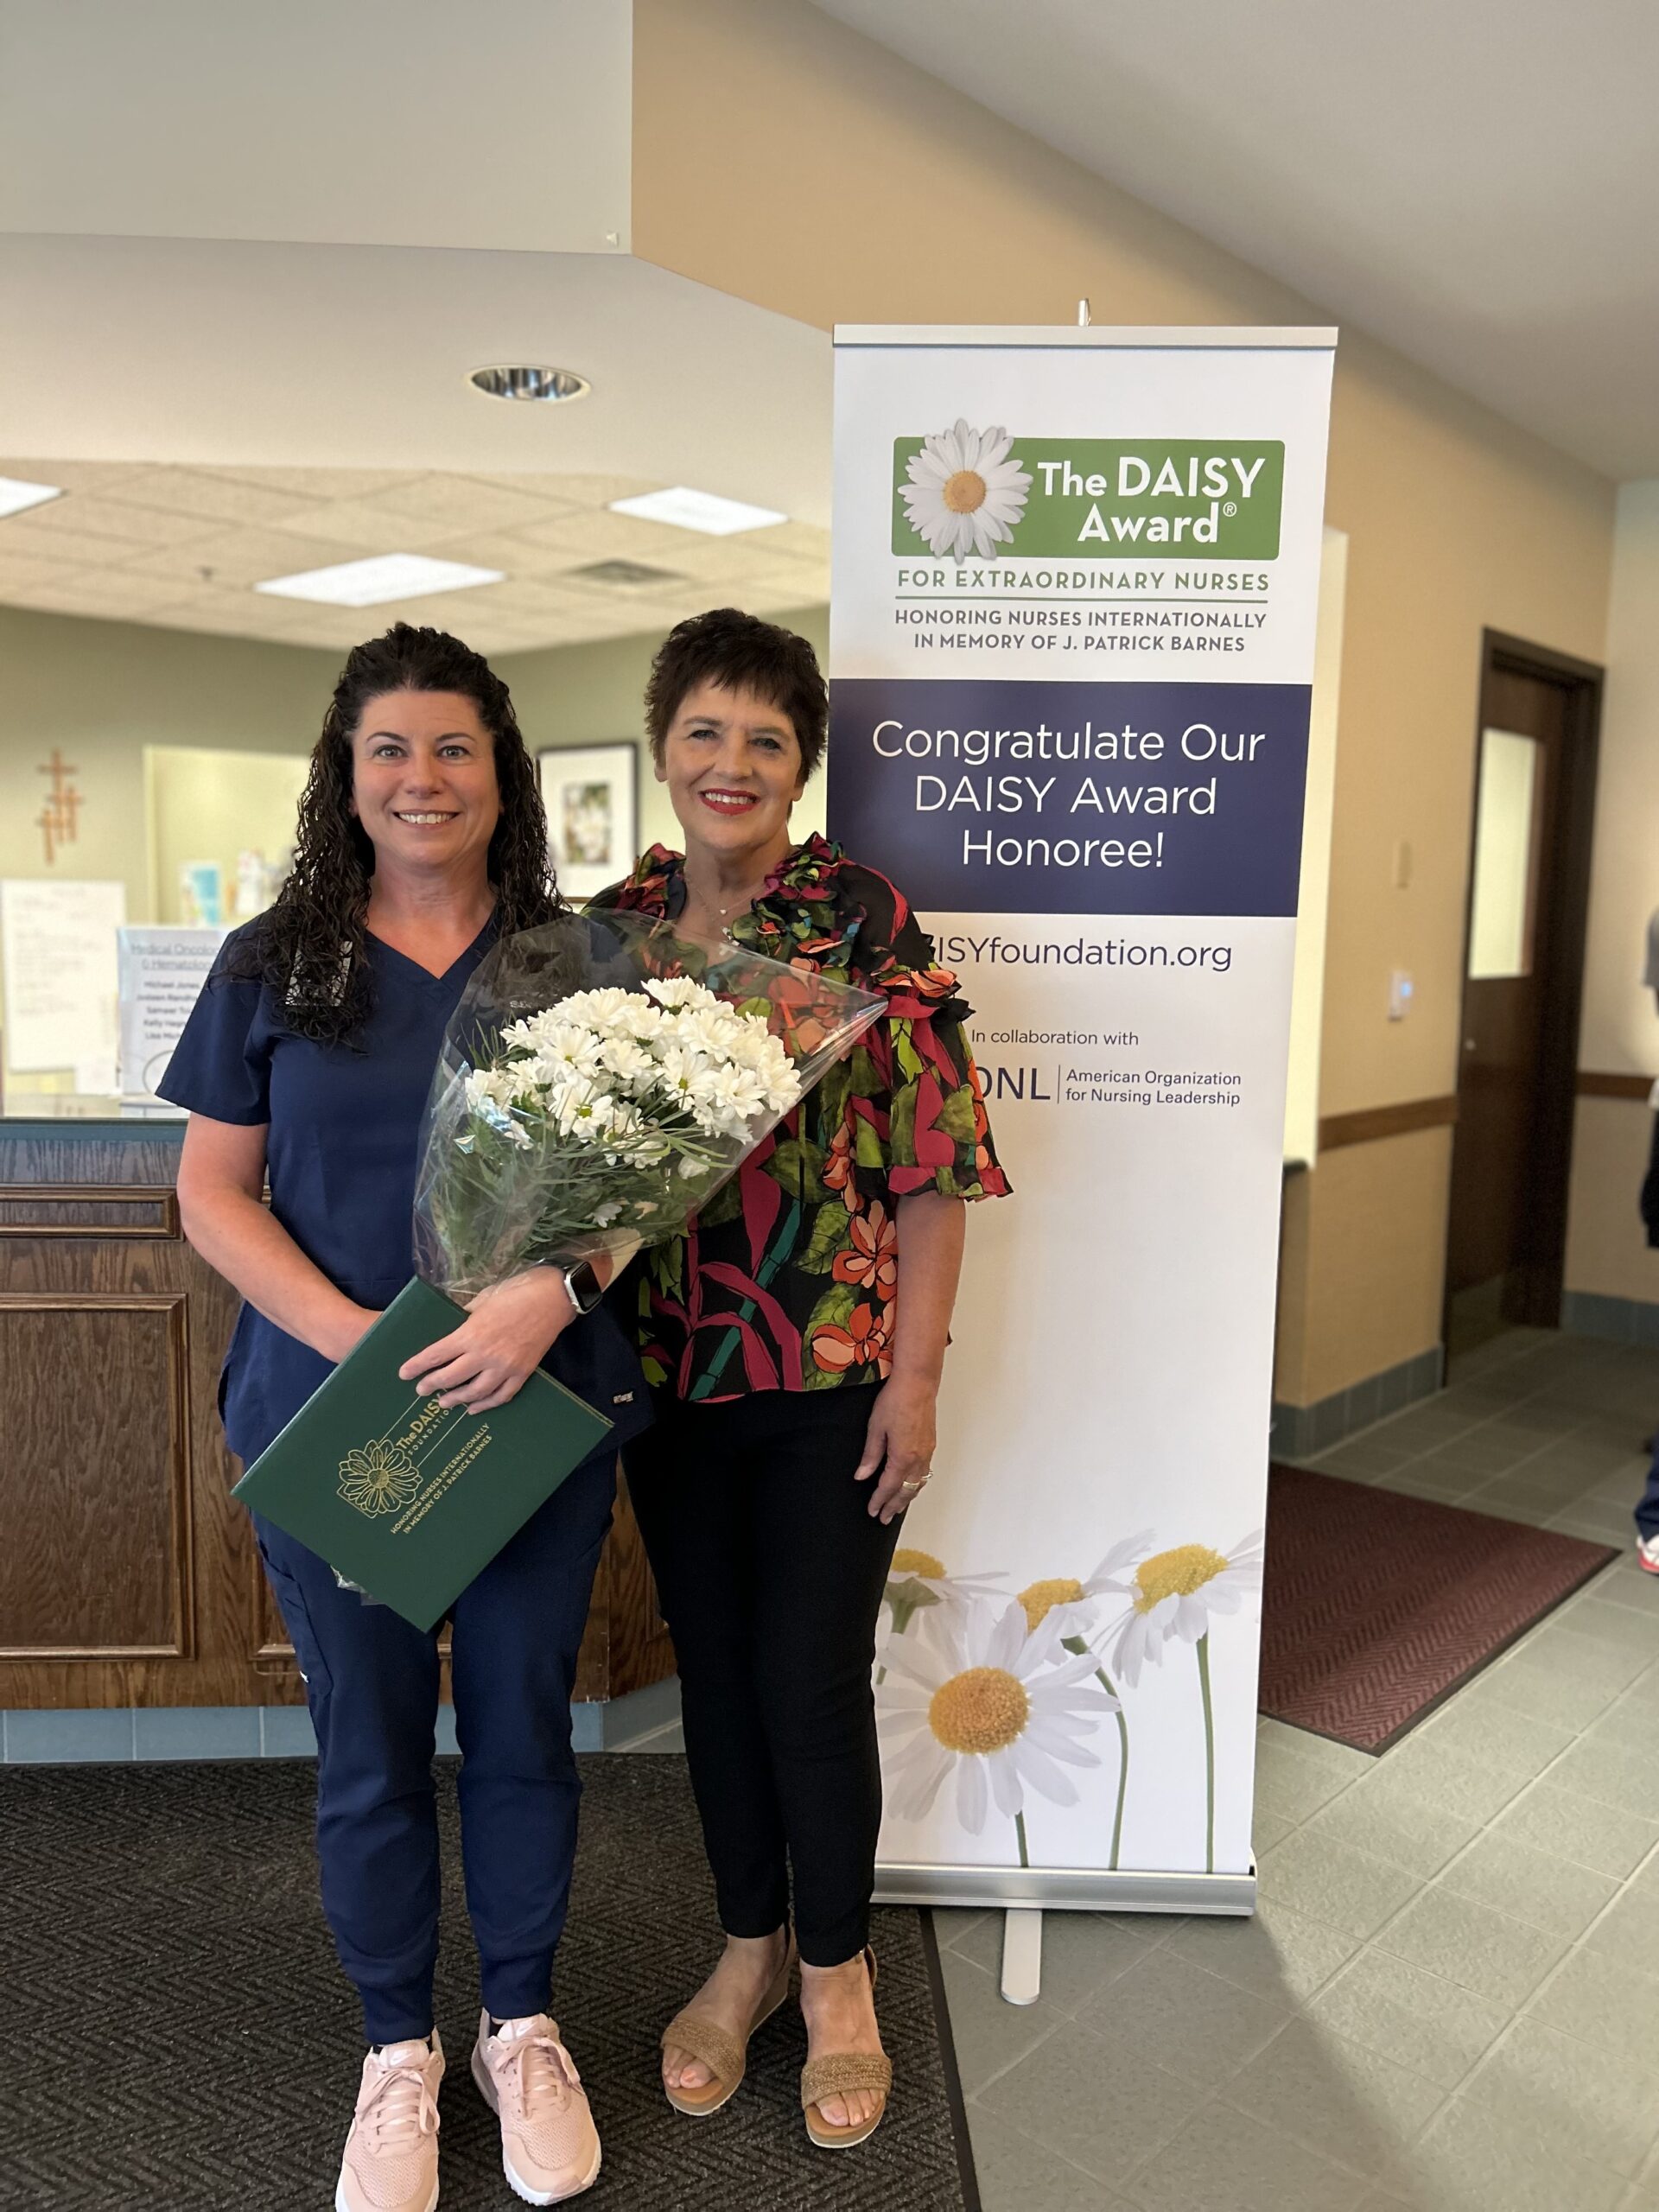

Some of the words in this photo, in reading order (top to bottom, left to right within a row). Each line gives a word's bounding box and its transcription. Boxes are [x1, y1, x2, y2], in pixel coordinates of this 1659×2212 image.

[1038, 461, 1107, 496] The
[1118, 457, 1265, 497] DAISY
[899, 570, 944, 587] FOR
[957, 570, 1164, 588] EXTRAORDINARY
[1175, 573, 1268, 590] NURSES
[896, 610, 1001, 624] HONORING
[1009, 611, 1081, 626] NURSES
[1089, 613, 1266, 627] INTERNATIONALLY
[915, 634, 932, 647] IN
[940, 634, 1025, 648] MEMORY
[1032, 635, 1057, 649] OF
[1063, 636, 1077, 649] J.
[1084, 636, 1164, 650] PATRICK
[1172, 637, 1244, 652] BARNES
[874, 721, 1164, 765] Congratulate
[1182, 724, 1265, 760] Our
[917, 776, 1056, 812] DAISY
[1071, 778, 1216, 814] Award
[964, 830, 1163, 867] Honoree!
[938, 936, 1231, 972] ISYfoundation.org
[972, 1030, 985, 1042] In
[991, 1030, 1096, 1044] collaboration
[1103, 1032, 1138, 1045] with
[1066, 1070, 1140, 1083] American
[1146, 1071, 1240, 1086] Organization
[1066, 1088, 1086, 1100] for
[1092, 1089, 1151, 1105] Nursing
[1157, 1090, 1239, 1106] Leadership
[396, 1432, 417, 1449] The
[408, 1406, 454, 1456] FOUNDATIO
[390, 1500, 422, 1535] HONORING
[419, 1477, 442, 1502] NURSES
[439, 1422, 490, 1478] INTERNATIONALLY
[403, 1524, 412, 1534] IN
[410, 1497, 435, 1527] MEMORY
[433, 1490, 443, 1500] OF
[446, 1459, 472, 1485] PATRICK
[468, 1434, 493, 1460] BARNES
